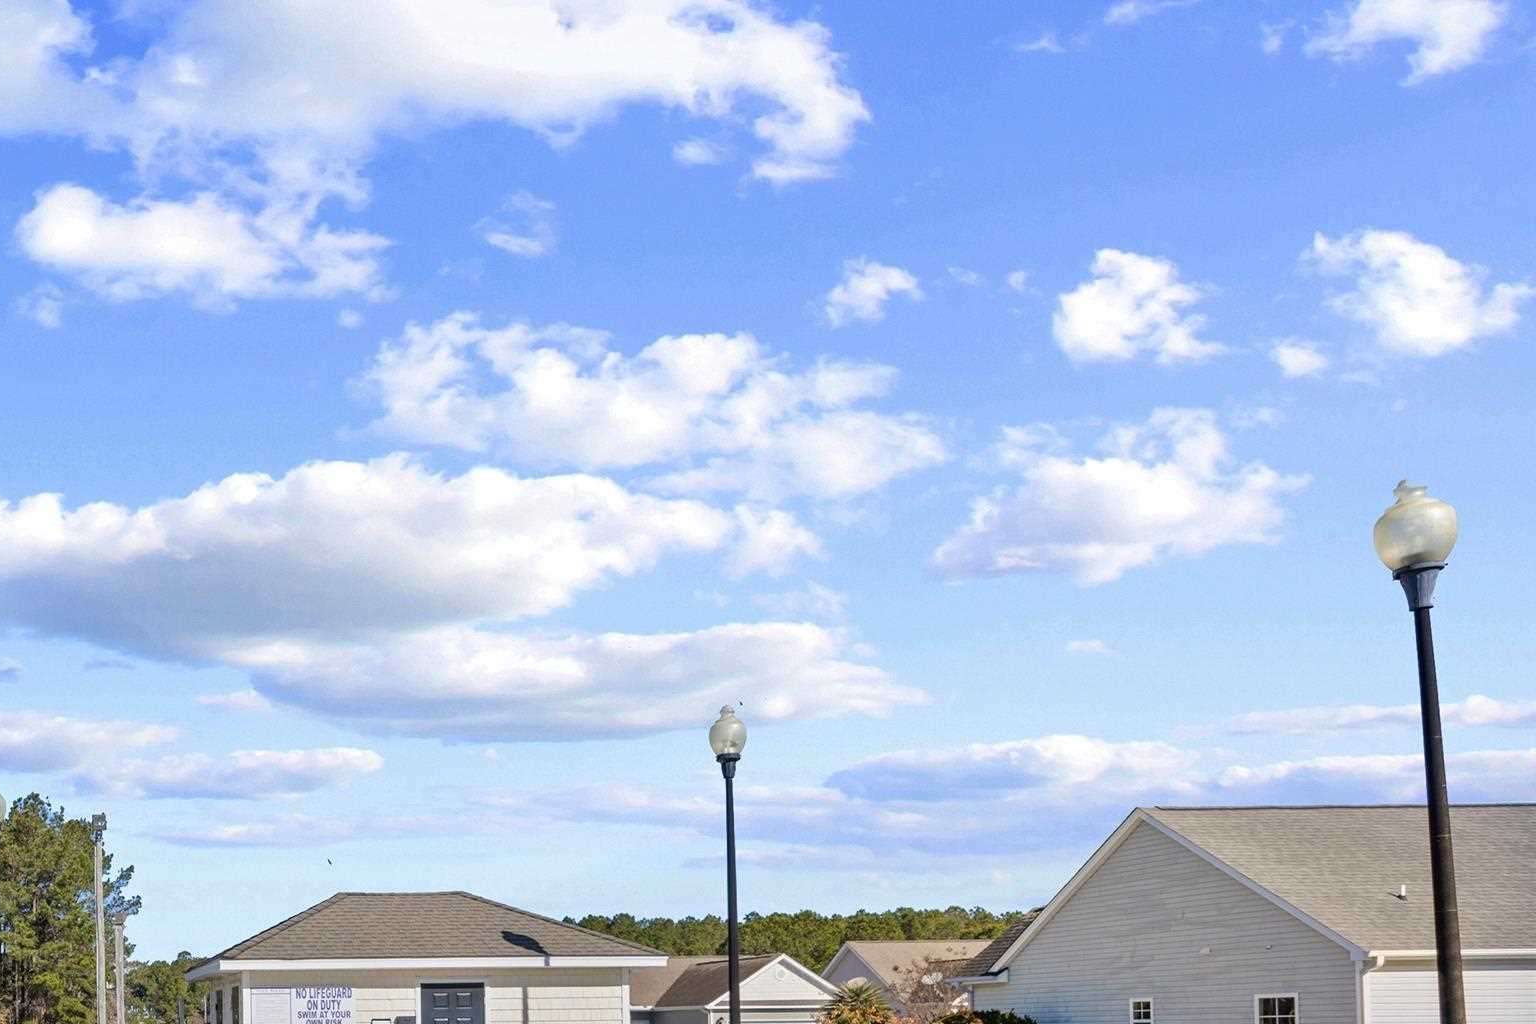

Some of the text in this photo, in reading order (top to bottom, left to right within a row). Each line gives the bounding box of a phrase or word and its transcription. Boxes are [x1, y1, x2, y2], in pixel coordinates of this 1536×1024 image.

[295, 987, 353, 999] NO LIFEGUARD
[306, 1000, 342, 1011] ON DUTY
[297, 1011, 351, 1019] SWIM AT YOUR
